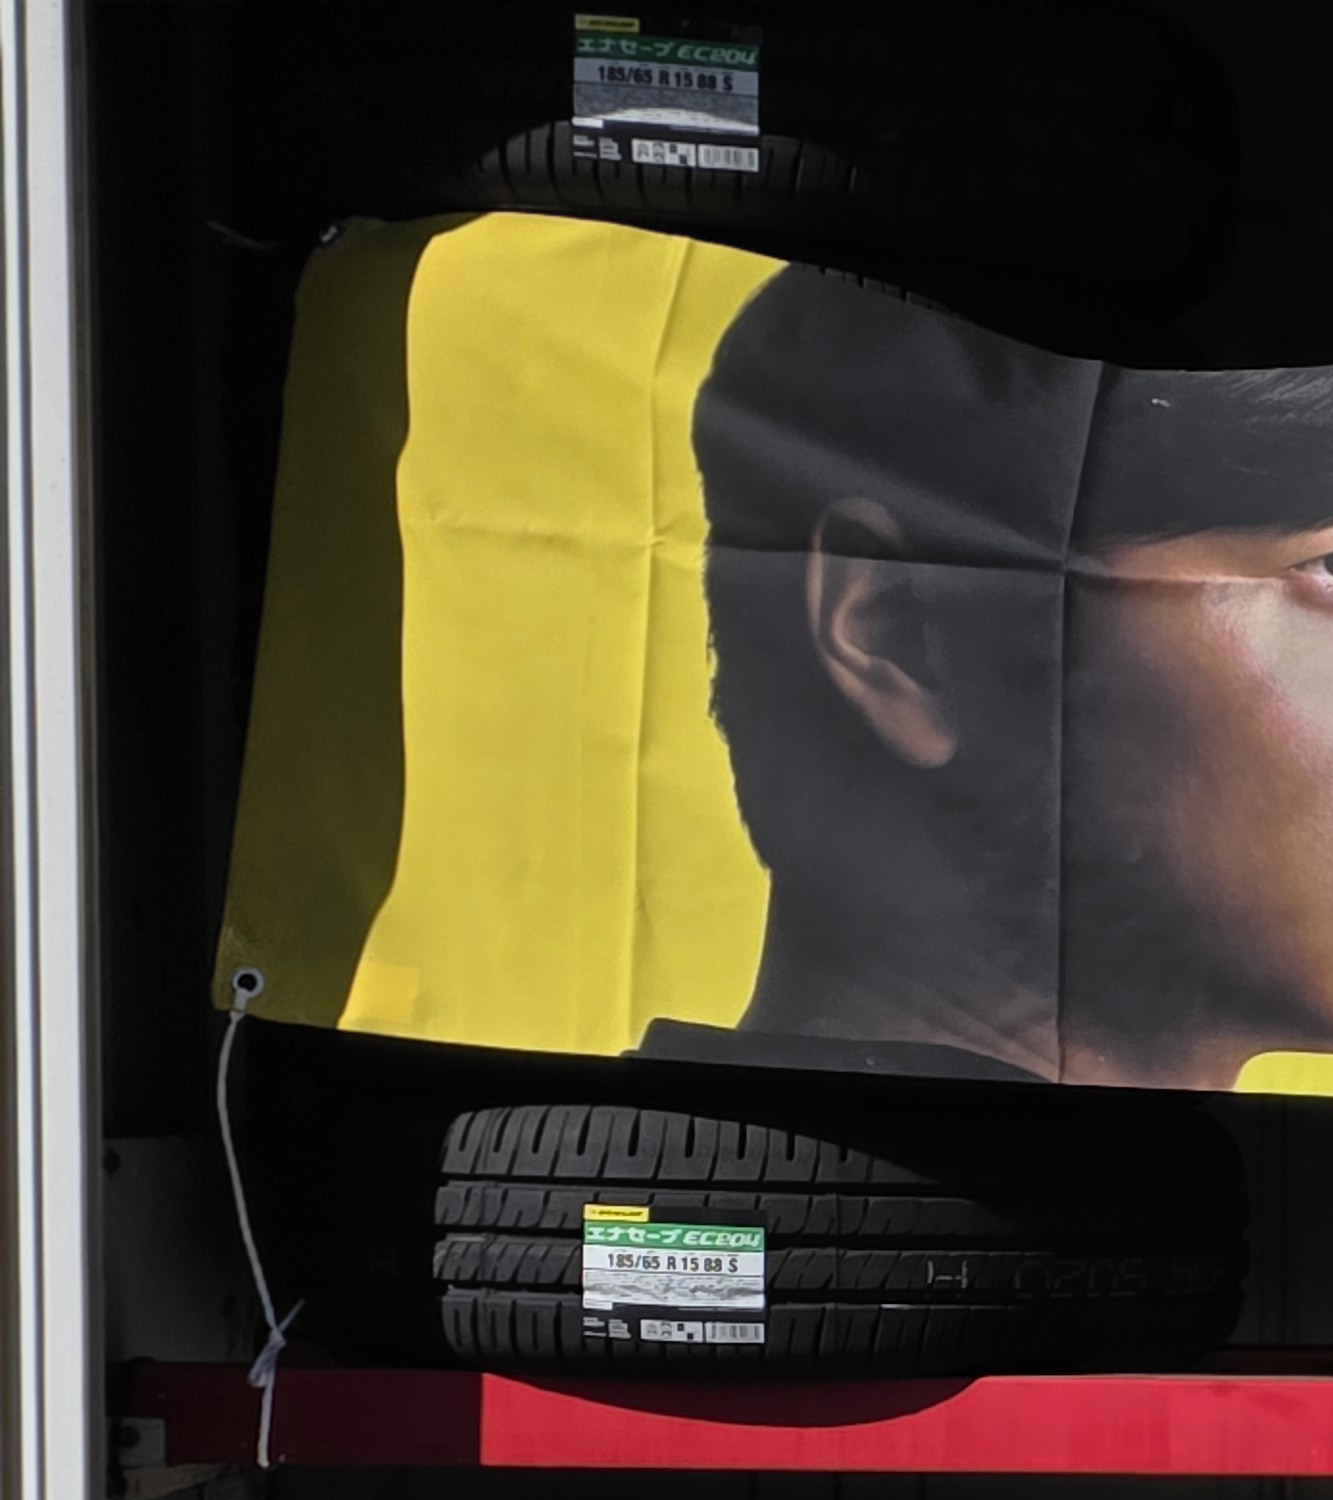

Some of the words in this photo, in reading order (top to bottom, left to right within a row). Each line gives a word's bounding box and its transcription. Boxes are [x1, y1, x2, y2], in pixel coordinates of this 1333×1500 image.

[722, 75, 733, 92] S
[586, 1226, 683, 1243] エナセーブ
[683, 1230, 761, 1247] EC204
[607, 1253, 661, 1270] 185/65
[667, 1256, 677, 1270] R
[682, 1257, 699, 1271] 15
[704, 1257, 723, 1272] 88
[728, 1258, 739, 1273] S
